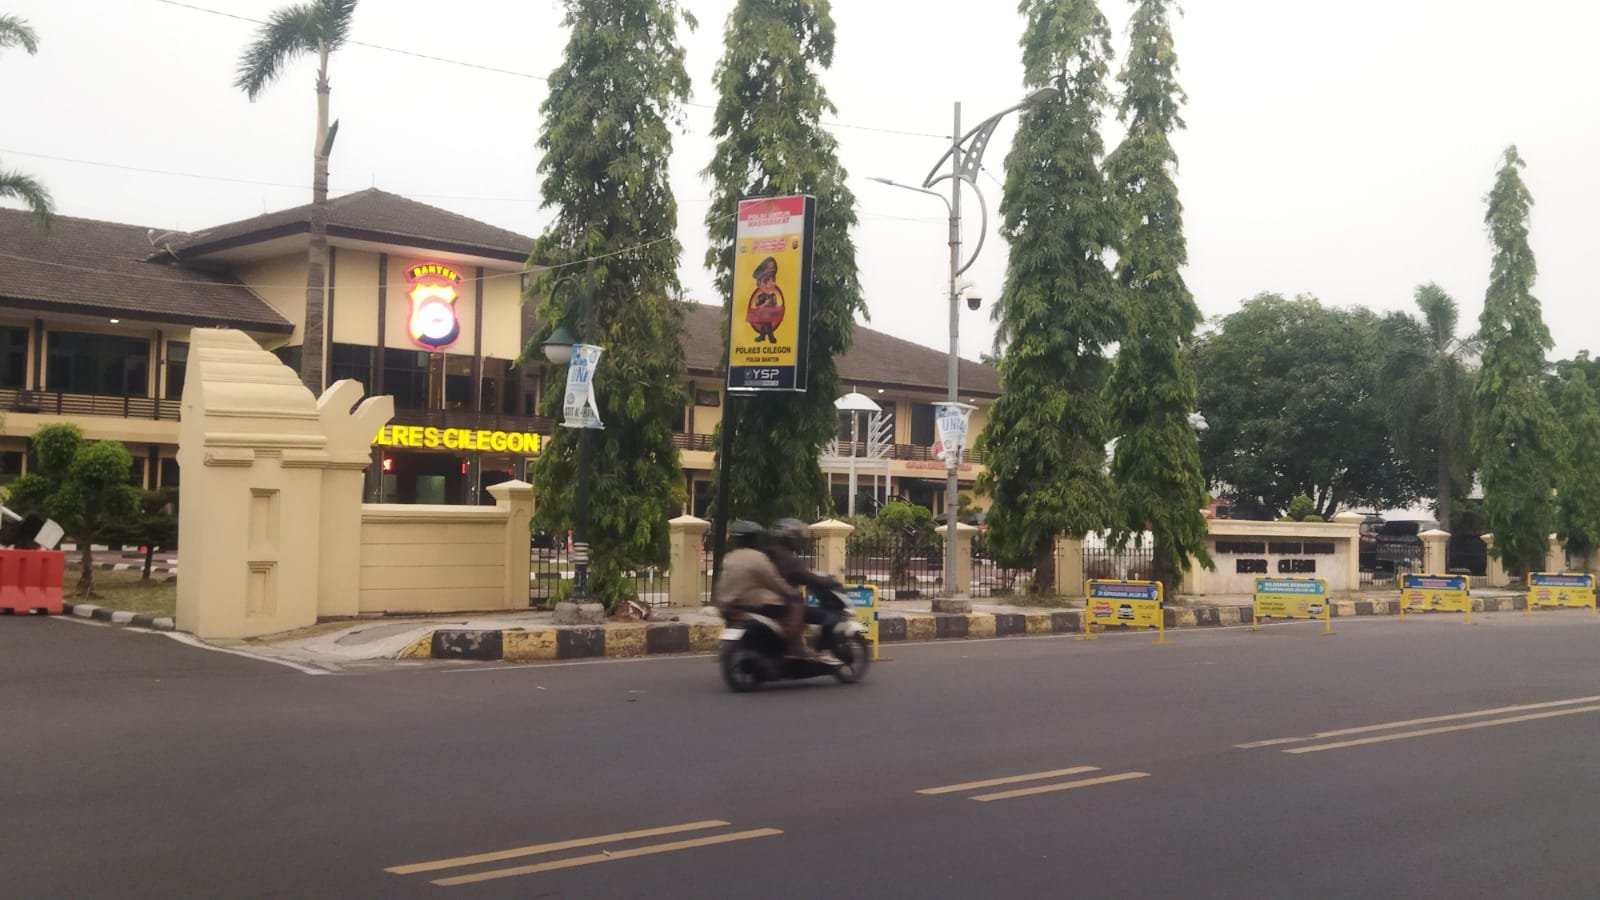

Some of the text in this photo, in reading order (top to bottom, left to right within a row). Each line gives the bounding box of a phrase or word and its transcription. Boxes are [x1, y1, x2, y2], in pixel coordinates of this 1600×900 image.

[413, 264, 457, 281] BANTEN
[762, 346, 791, 354] CILEGON
[752, 369, 780, 379] YSP
[442, 428, 539, 452] CILEGON
